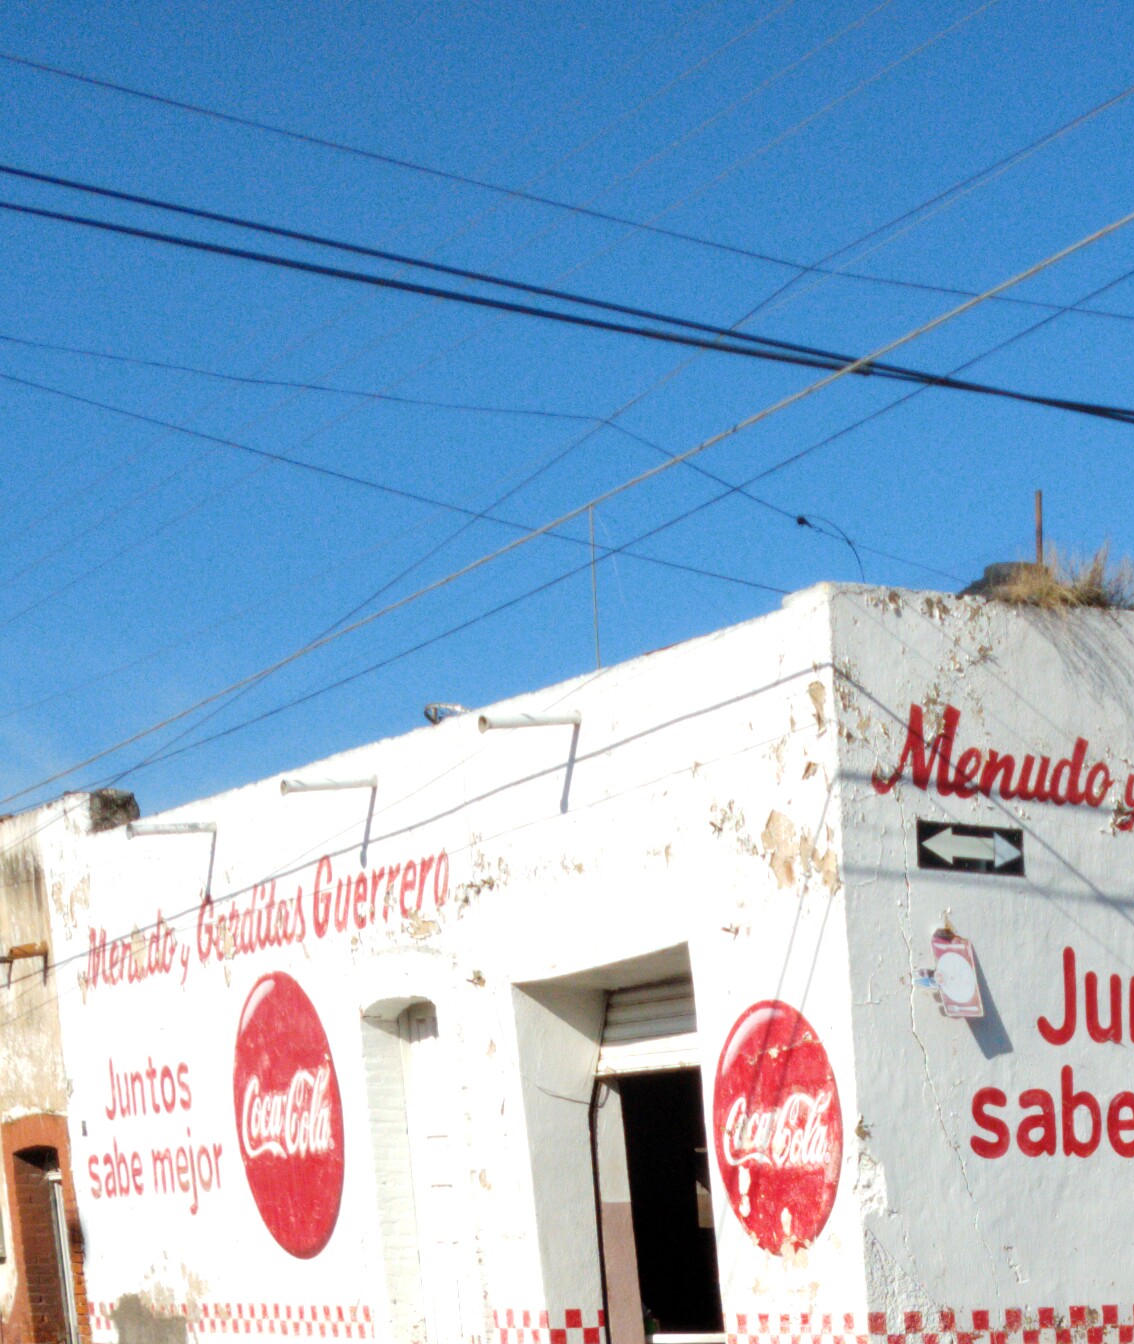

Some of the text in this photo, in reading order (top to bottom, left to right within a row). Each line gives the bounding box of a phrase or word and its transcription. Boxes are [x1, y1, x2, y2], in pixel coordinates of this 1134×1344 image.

[872, 703, 1113, 808] Menudo
[181, 942, 190, 986] y
[197, 878, 306, 963] Gorditas
[312, 851, 449, 938] Guerrero
[106, 1055, 192, 1121] Juntos
[242, 1067, 335, 1159] Coca-Cola
[87, 1126, 223, 1216] sabe mejor
